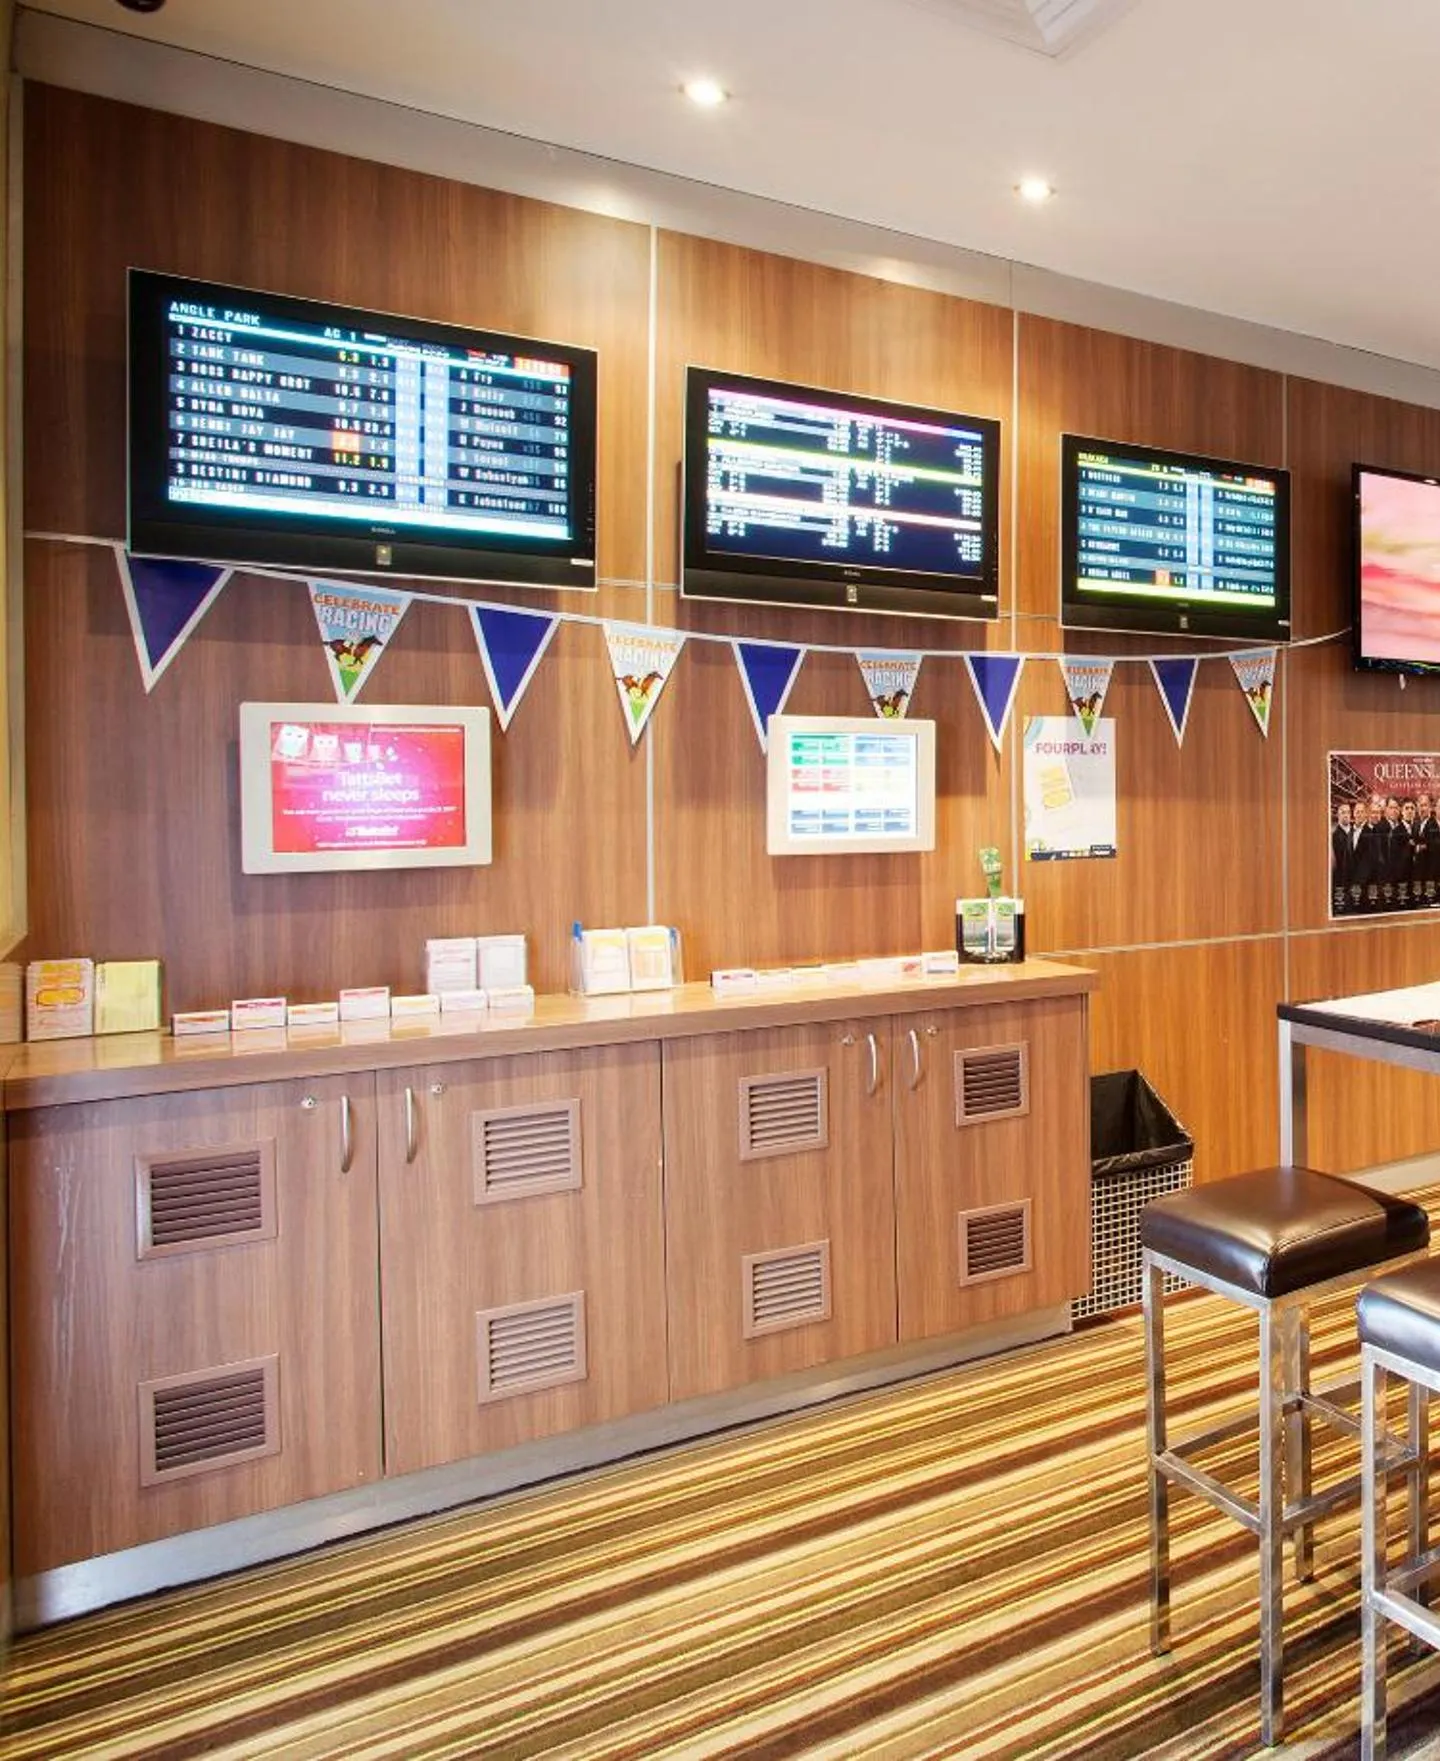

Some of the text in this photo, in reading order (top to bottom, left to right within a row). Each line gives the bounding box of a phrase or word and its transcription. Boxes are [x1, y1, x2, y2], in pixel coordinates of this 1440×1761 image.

[170, 301, 260, 326] ANGLE PARK
[320, 606, 393, 634] RACING
[322, 787, 420, 803] never sleeps
